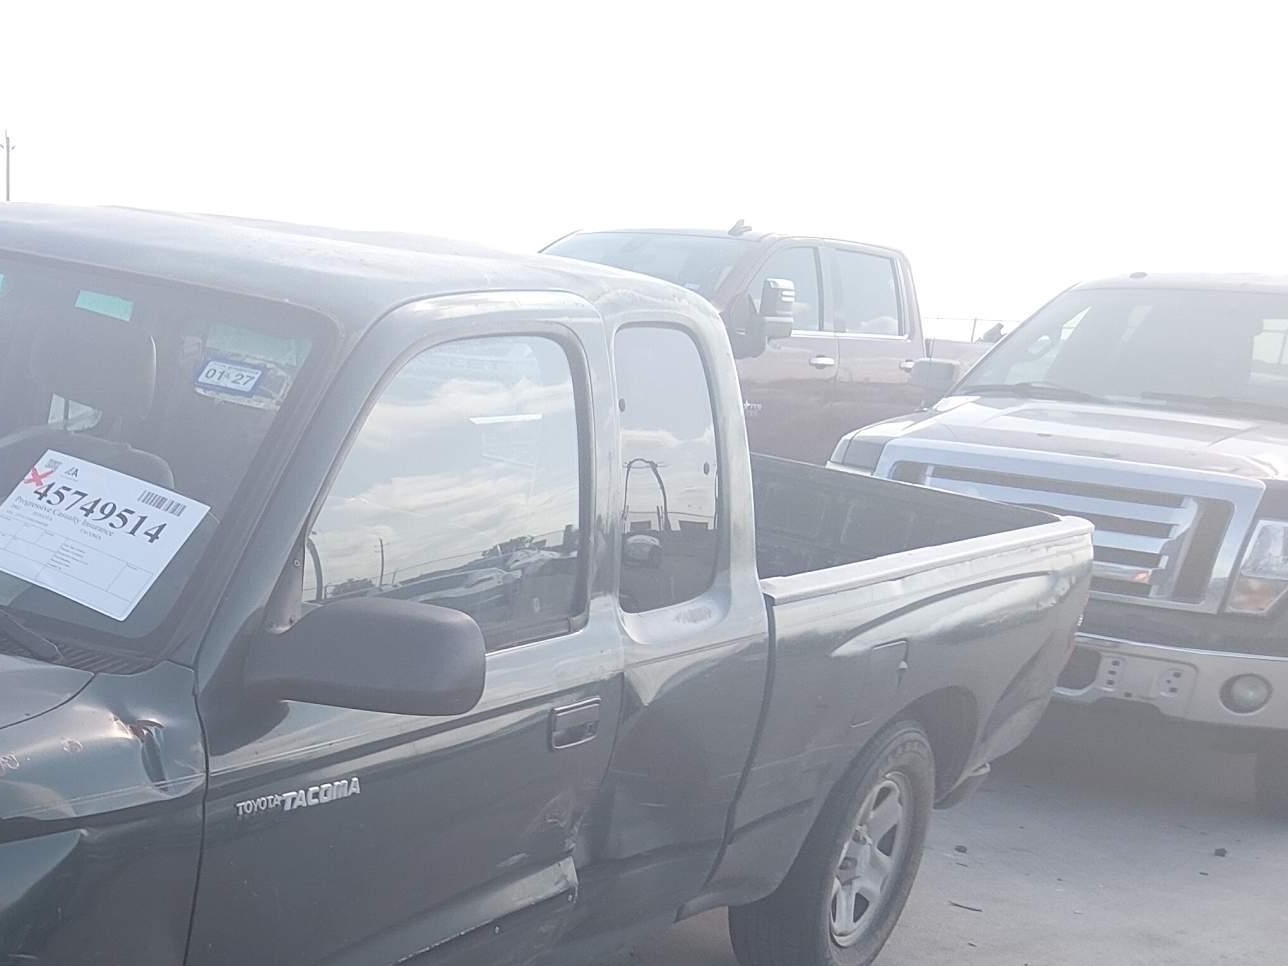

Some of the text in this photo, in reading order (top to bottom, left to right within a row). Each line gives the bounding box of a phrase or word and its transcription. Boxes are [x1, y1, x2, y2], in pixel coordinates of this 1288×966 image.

[205, 369, 255, 386] 01 27
[33, 482, 167, 543] 45749514
[236, 777, 360, 815] TOYOTA TACOMA
